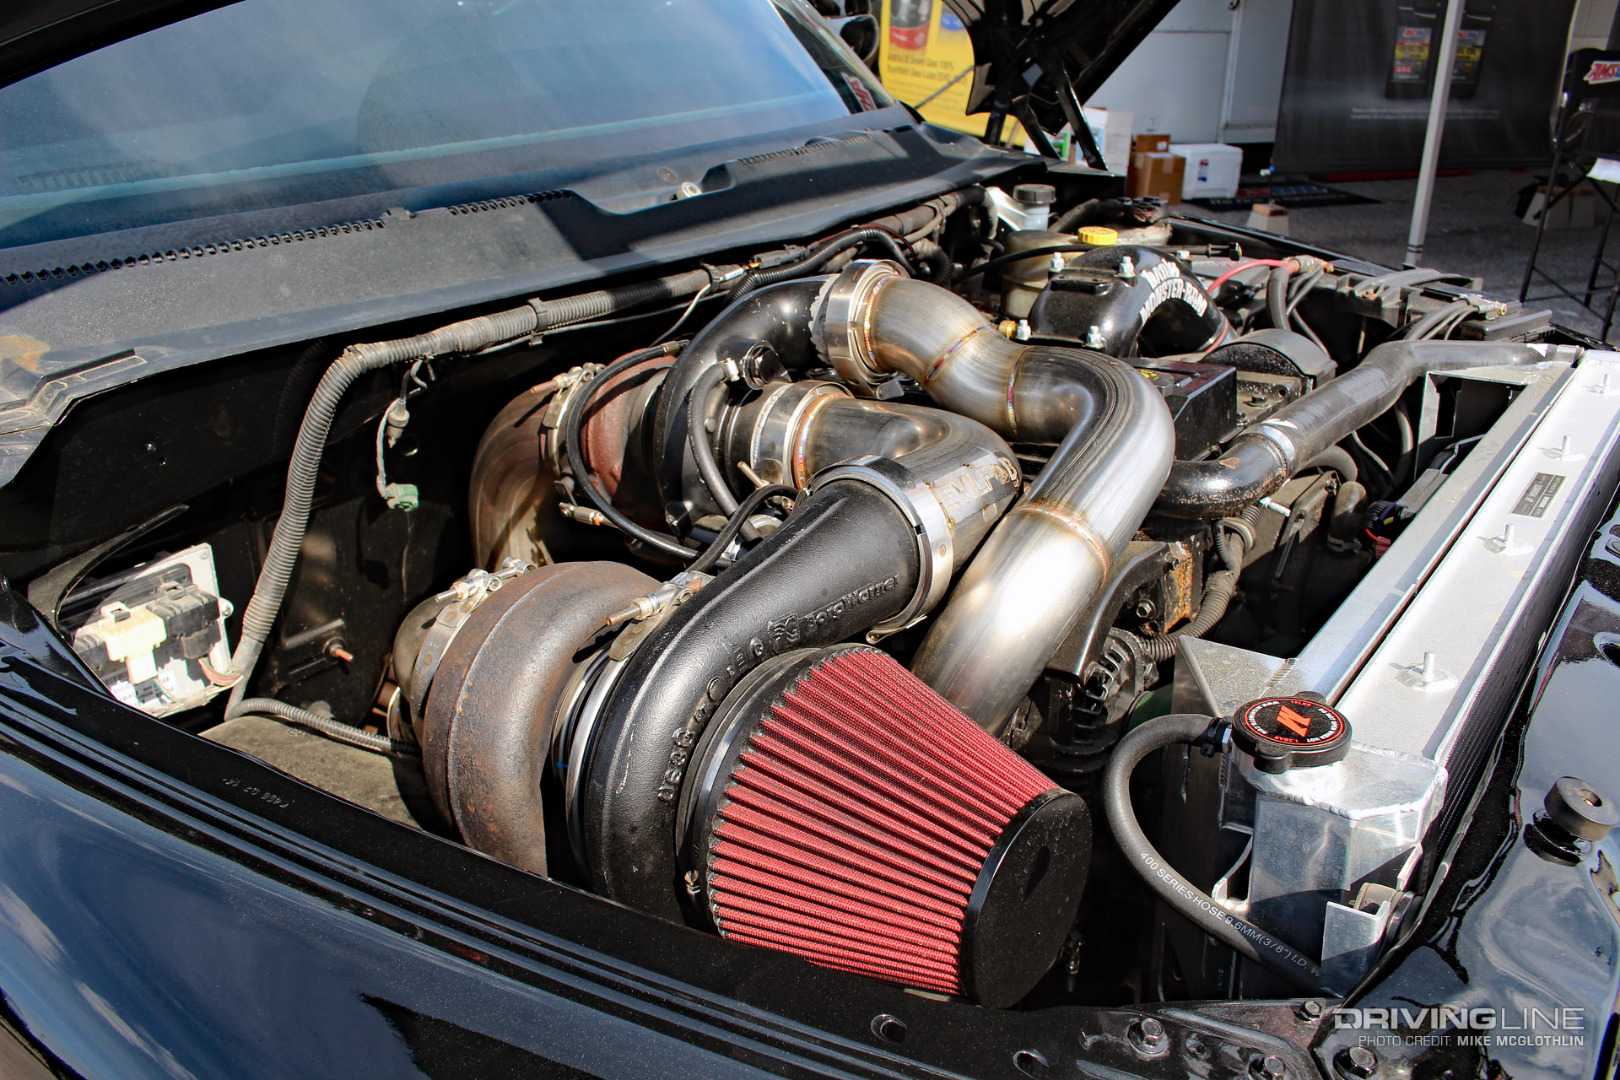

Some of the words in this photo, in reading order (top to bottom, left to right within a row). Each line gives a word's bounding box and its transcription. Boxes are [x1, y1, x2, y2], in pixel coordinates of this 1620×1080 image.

[1587, 62, 1620, 82] AMS
[1139, 278, 1208, 325] MONSTER-RAM
[805, 574, 899, 629] BorgWarner
[1140, 852, 1159, 870] 400
[1156, 868, 1194, 900] SERIES
[1192, 895, 1226, 920] HOSE
[1291, 954, 1307, 969] I.D.
